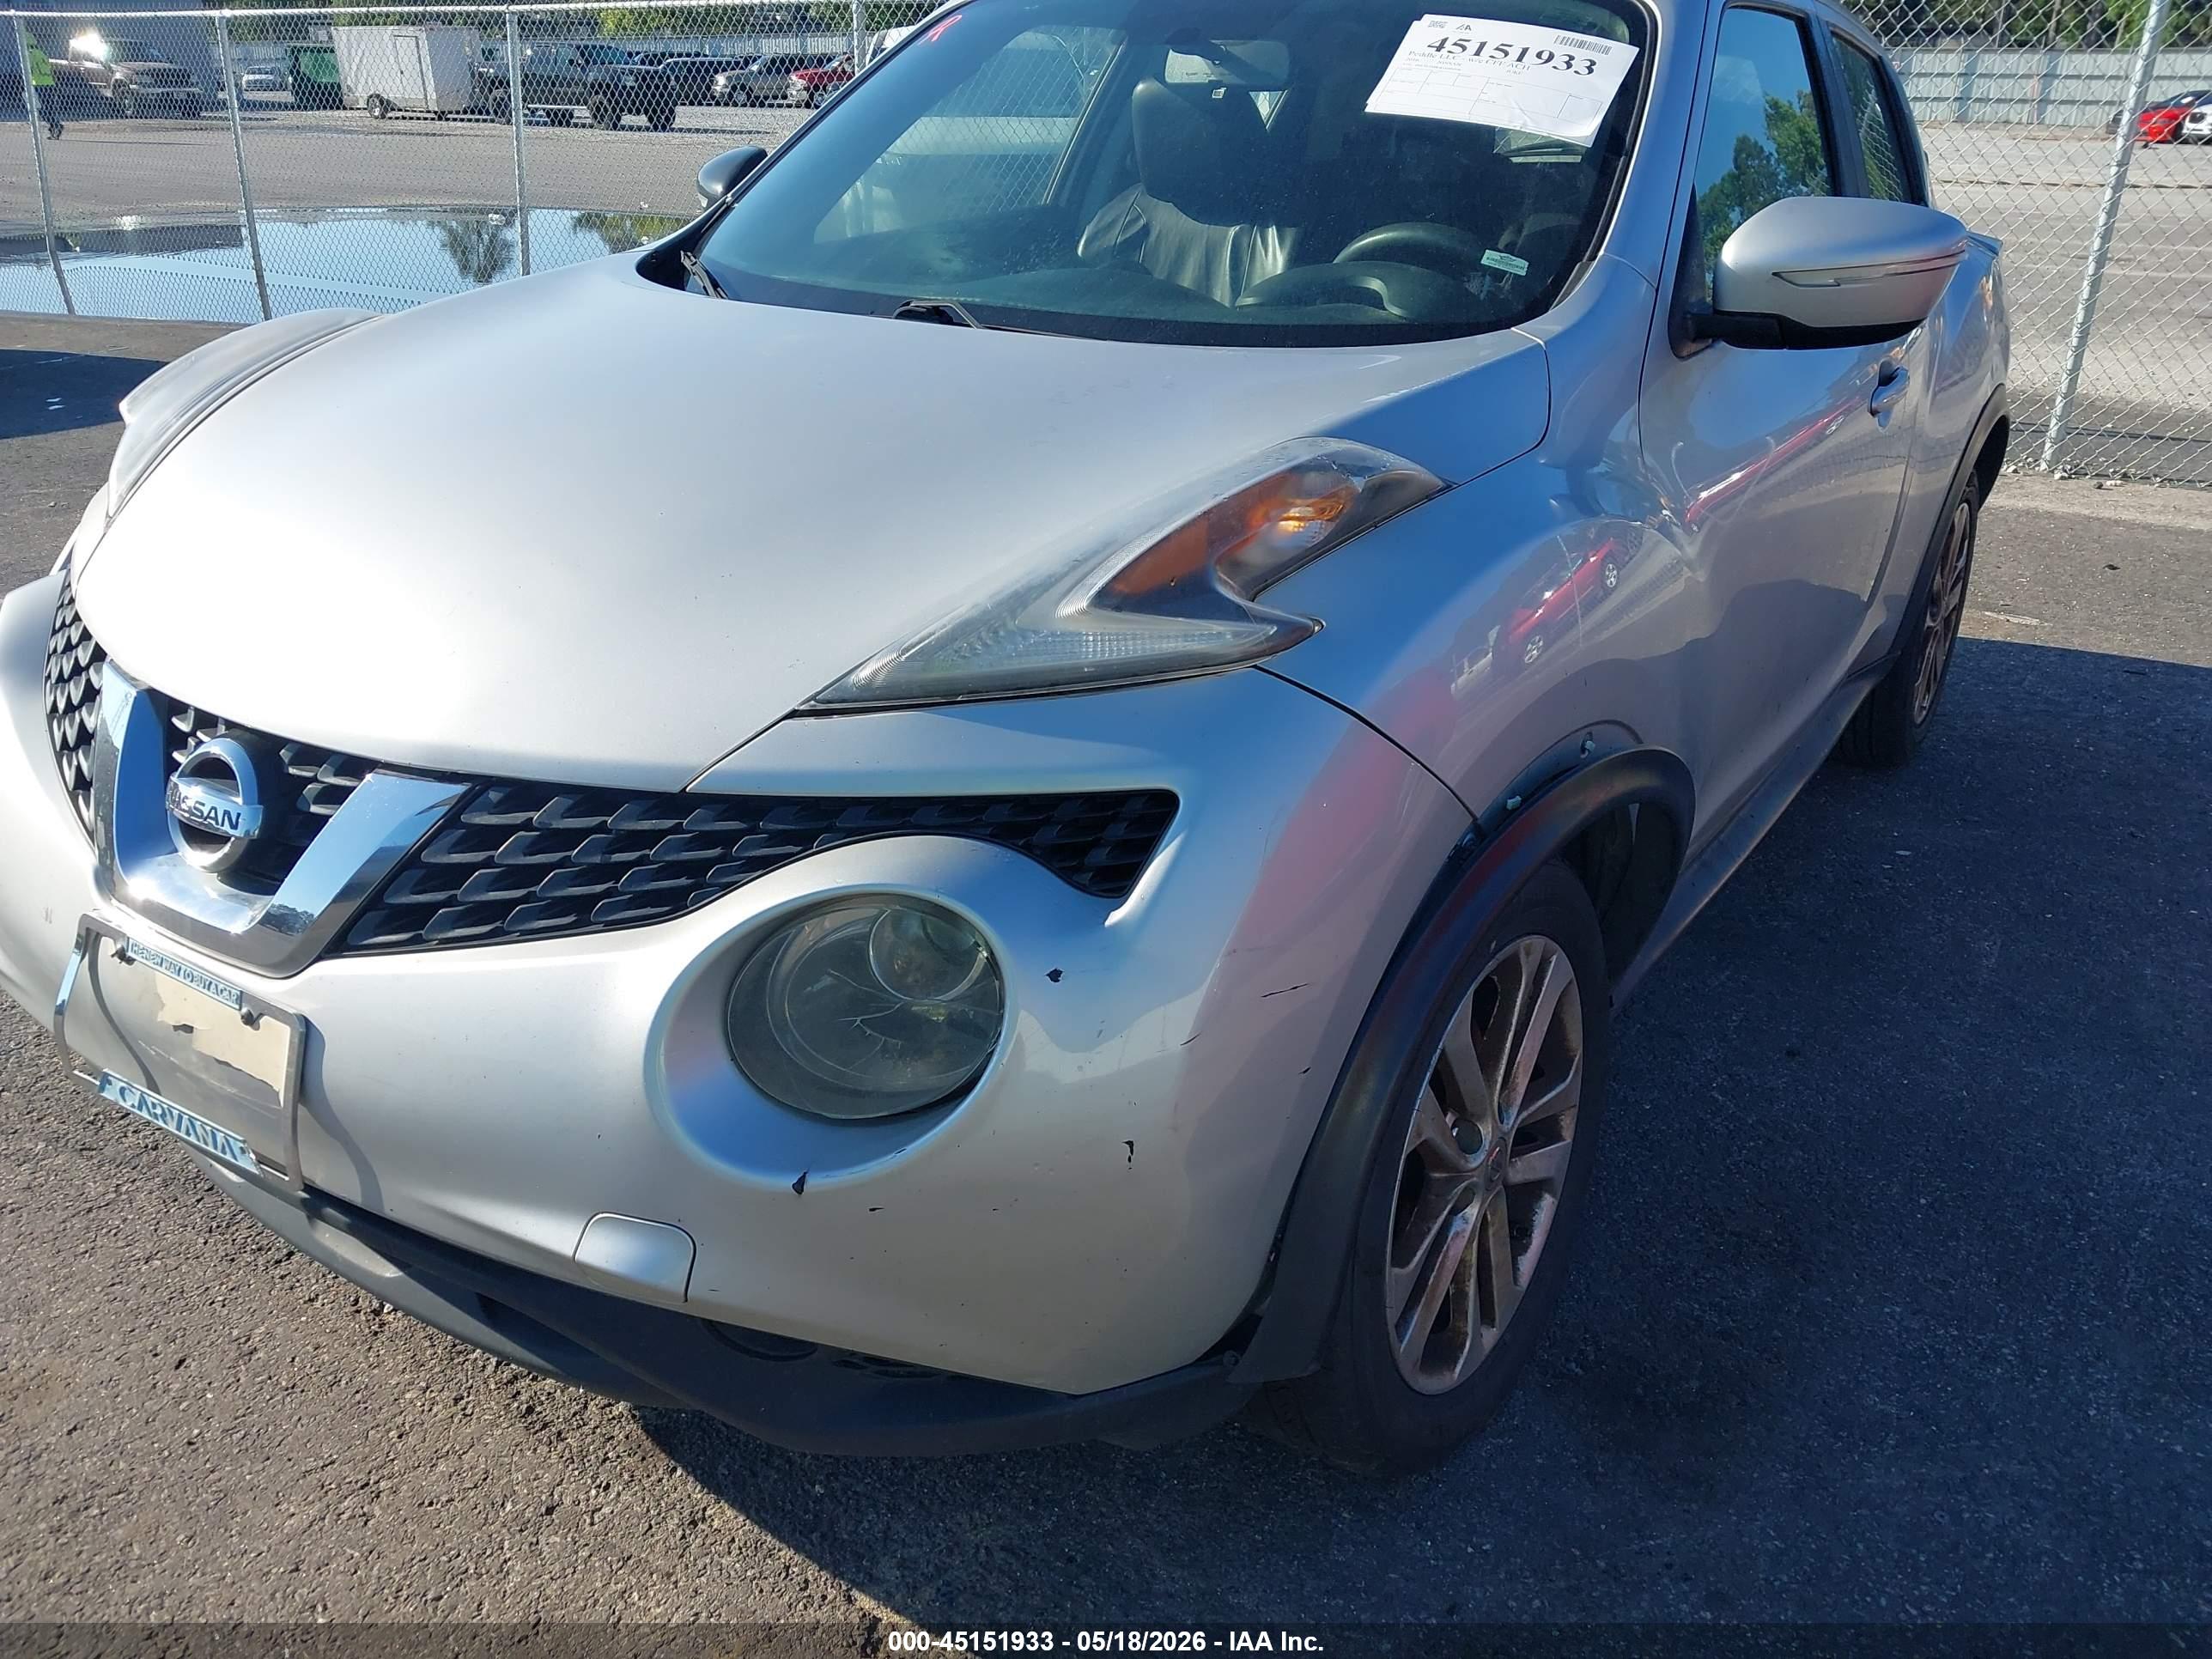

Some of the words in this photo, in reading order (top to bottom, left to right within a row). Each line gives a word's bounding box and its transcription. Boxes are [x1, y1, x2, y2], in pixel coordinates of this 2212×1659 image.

[1427, 36, 1597, 76] 45151933
[167, 787, 242, 831] NISSAN
[162, 956, 181, 977] WAY
[219, 985, 240, 1006] CAR
[118, 1084, 239, 1162] CARVANA
